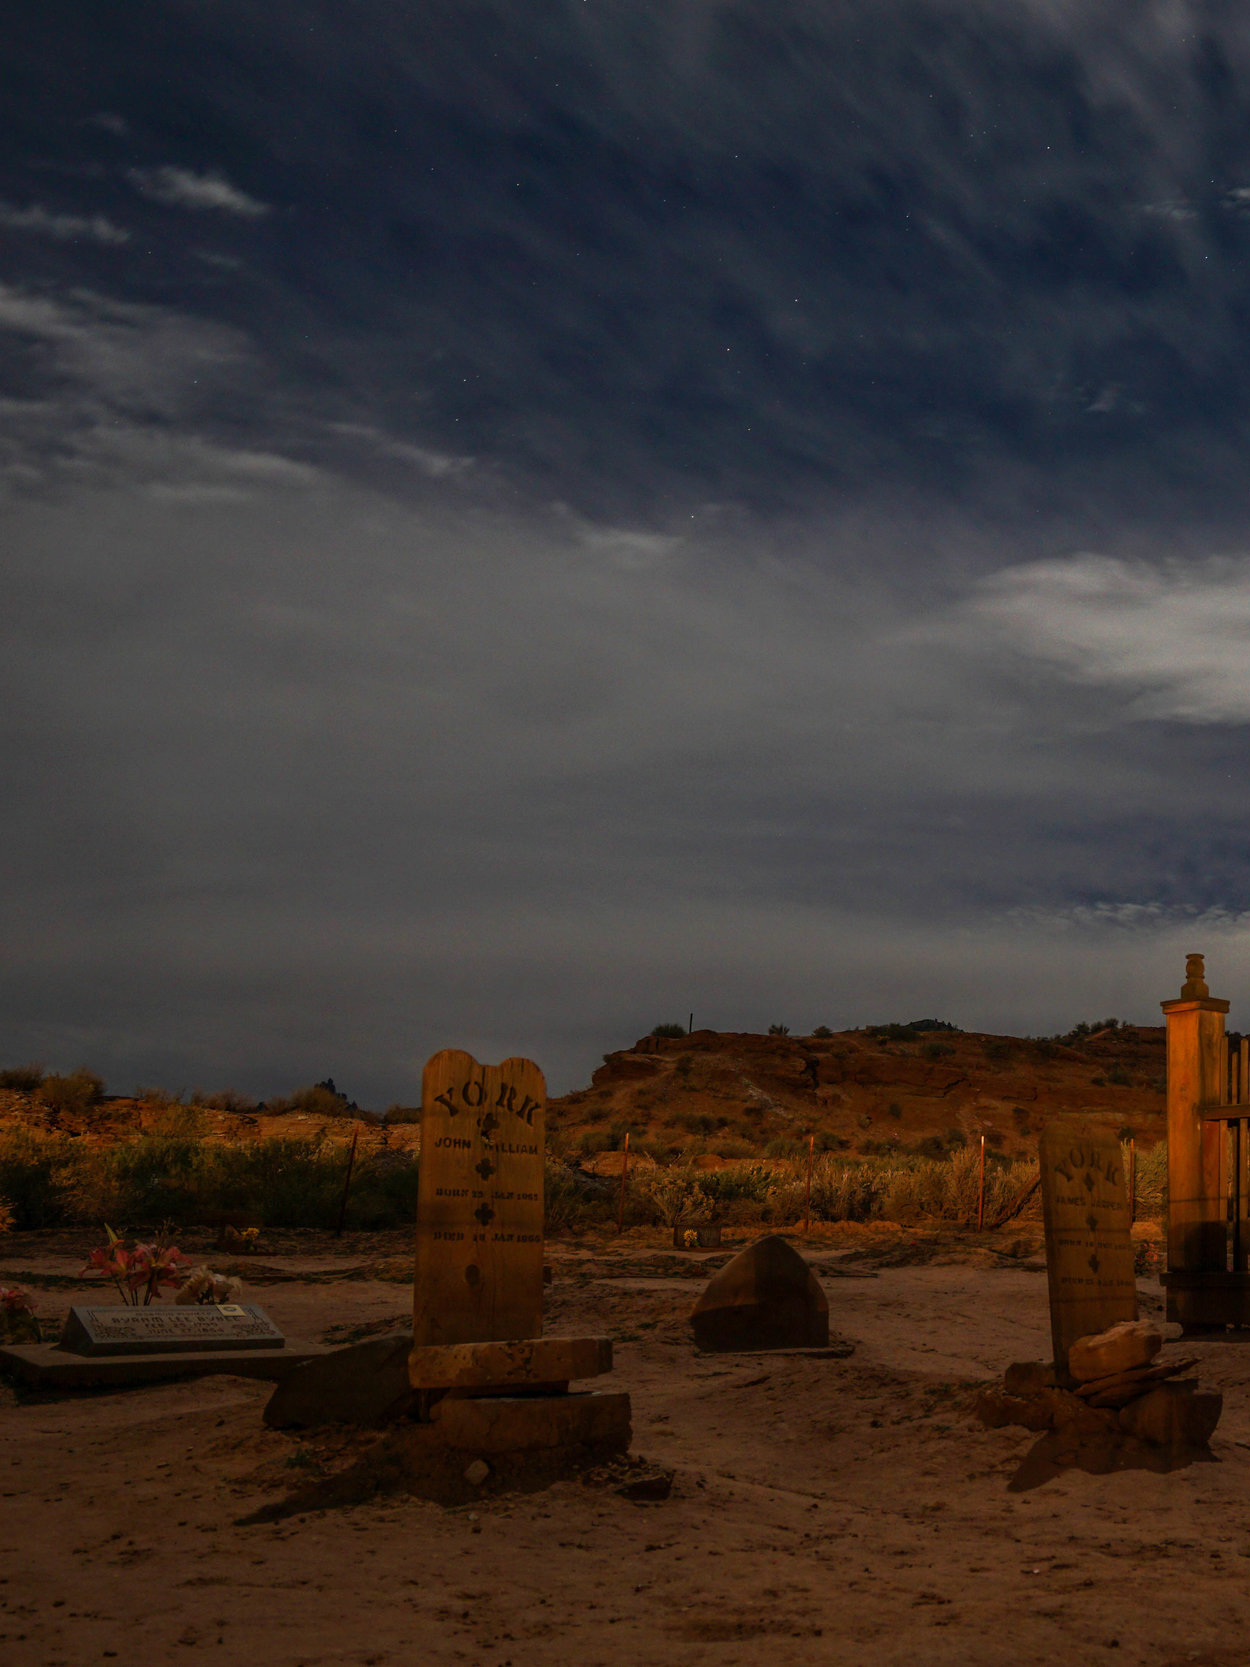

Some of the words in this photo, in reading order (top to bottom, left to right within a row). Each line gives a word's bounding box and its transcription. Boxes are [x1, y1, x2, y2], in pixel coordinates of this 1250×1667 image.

[434, 1081, 541, 1127] YORK
[435, 1137, 471, 1149] JOHN
[484, 1142, 538, 1155] WILLIAM
[1054, 1148, 1118, 1186] YORK
[435, 1188, 469, 1197] BORN
[433, 1232, 464, 1241] DIED
